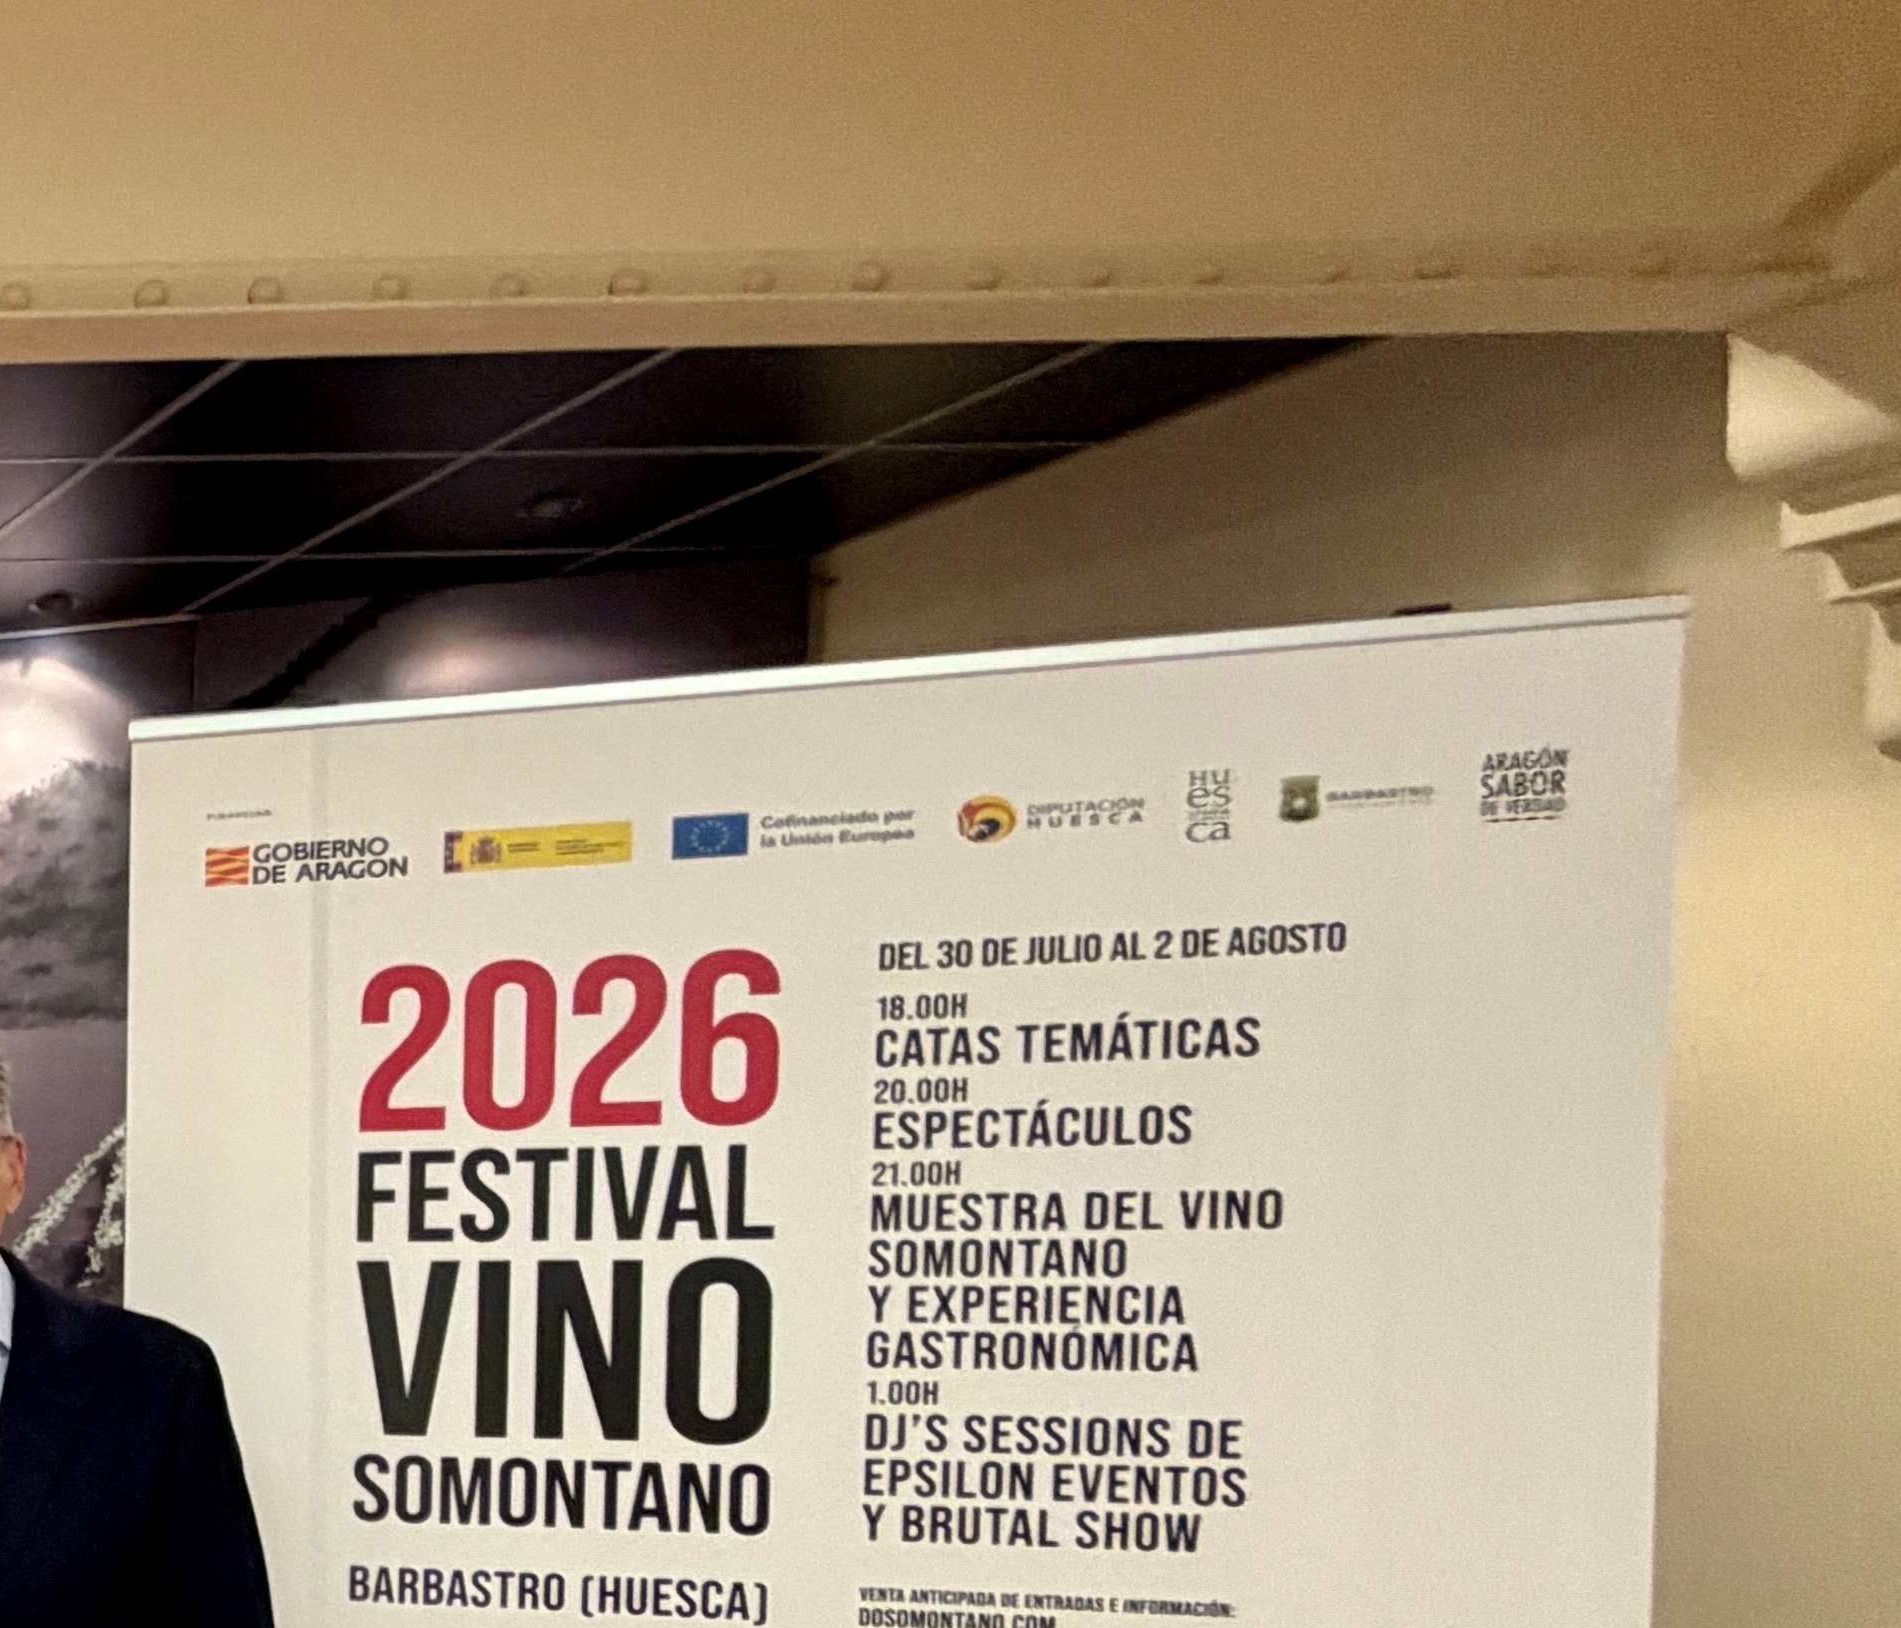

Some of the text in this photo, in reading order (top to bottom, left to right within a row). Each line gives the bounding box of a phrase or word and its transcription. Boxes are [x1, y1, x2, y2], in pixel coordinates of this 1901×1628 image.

[1482, 747, 1569, 773] ARAGÓN
[1481, 770, 1565, 797] SABOR
[761, 808, 915, 831] Cofinanciado por
[1027, 797, 1144, 815] DIPUTACIÓN
[1027, 812, 1143, 828] HUESCA
[254, 837, 388, 863] GOBIERNO
[761, 834, 776, 848] la
[781, 830, 834, 847] Unión
[253, 857, 407, 884] DE ARAGON
[879, 922, 1346, 970] DEL 30 DE JULIO AL 2 DE AGOSTO
[878, 993, 967, 1020] 18.00H
[360, 948, 780, 1132] 2026
[876, 1012, 1261, 1068] CATAS TEMÁTICAS
[874, 1077, 968, 1105] 20.00H
[873, 1100, 1192, 1150] ESPECTÁCULOS
[357, 1144, 774, 1242] FESTIVAL
[872, 1160, 961, 1186] 21.00H
[871, 1189, 1284, 1232] MUESTRA DEL VINO
[868, 1238, 1127, 1278] SOMONTANO
[869, 1285, 1185, 1325] Y EXPERIENCIA
[357, 1256, 773, 1445] VINO
[867, 1325, 1199, 1372] GASTRONÓMICA
[867, 1380, 939, 1406] 1.00H
[964, 1415, 1171, 1457] SESSIONS
[1188, 1419, 1244, 1459] DE
[352, 1454, 770, 1536] SOMONTANO
[864, 1459, 1247, 1507] EPSILON EVENTOS
[862, 1504, 1201, 1552] Y BRUTAL SHOW
[349, 1564, 767, 1625] BARBASTRO (HUESCA)
[859, 1587, 905, 1602] VENTA
[910, 1588, 996, 1607] ANTICIPADA
[1001, 1593, 1019, 1607] DE
[1024, 1594, 1104, 1612] ENTRADAS
[1109, 1598, 1119, 1611] E
